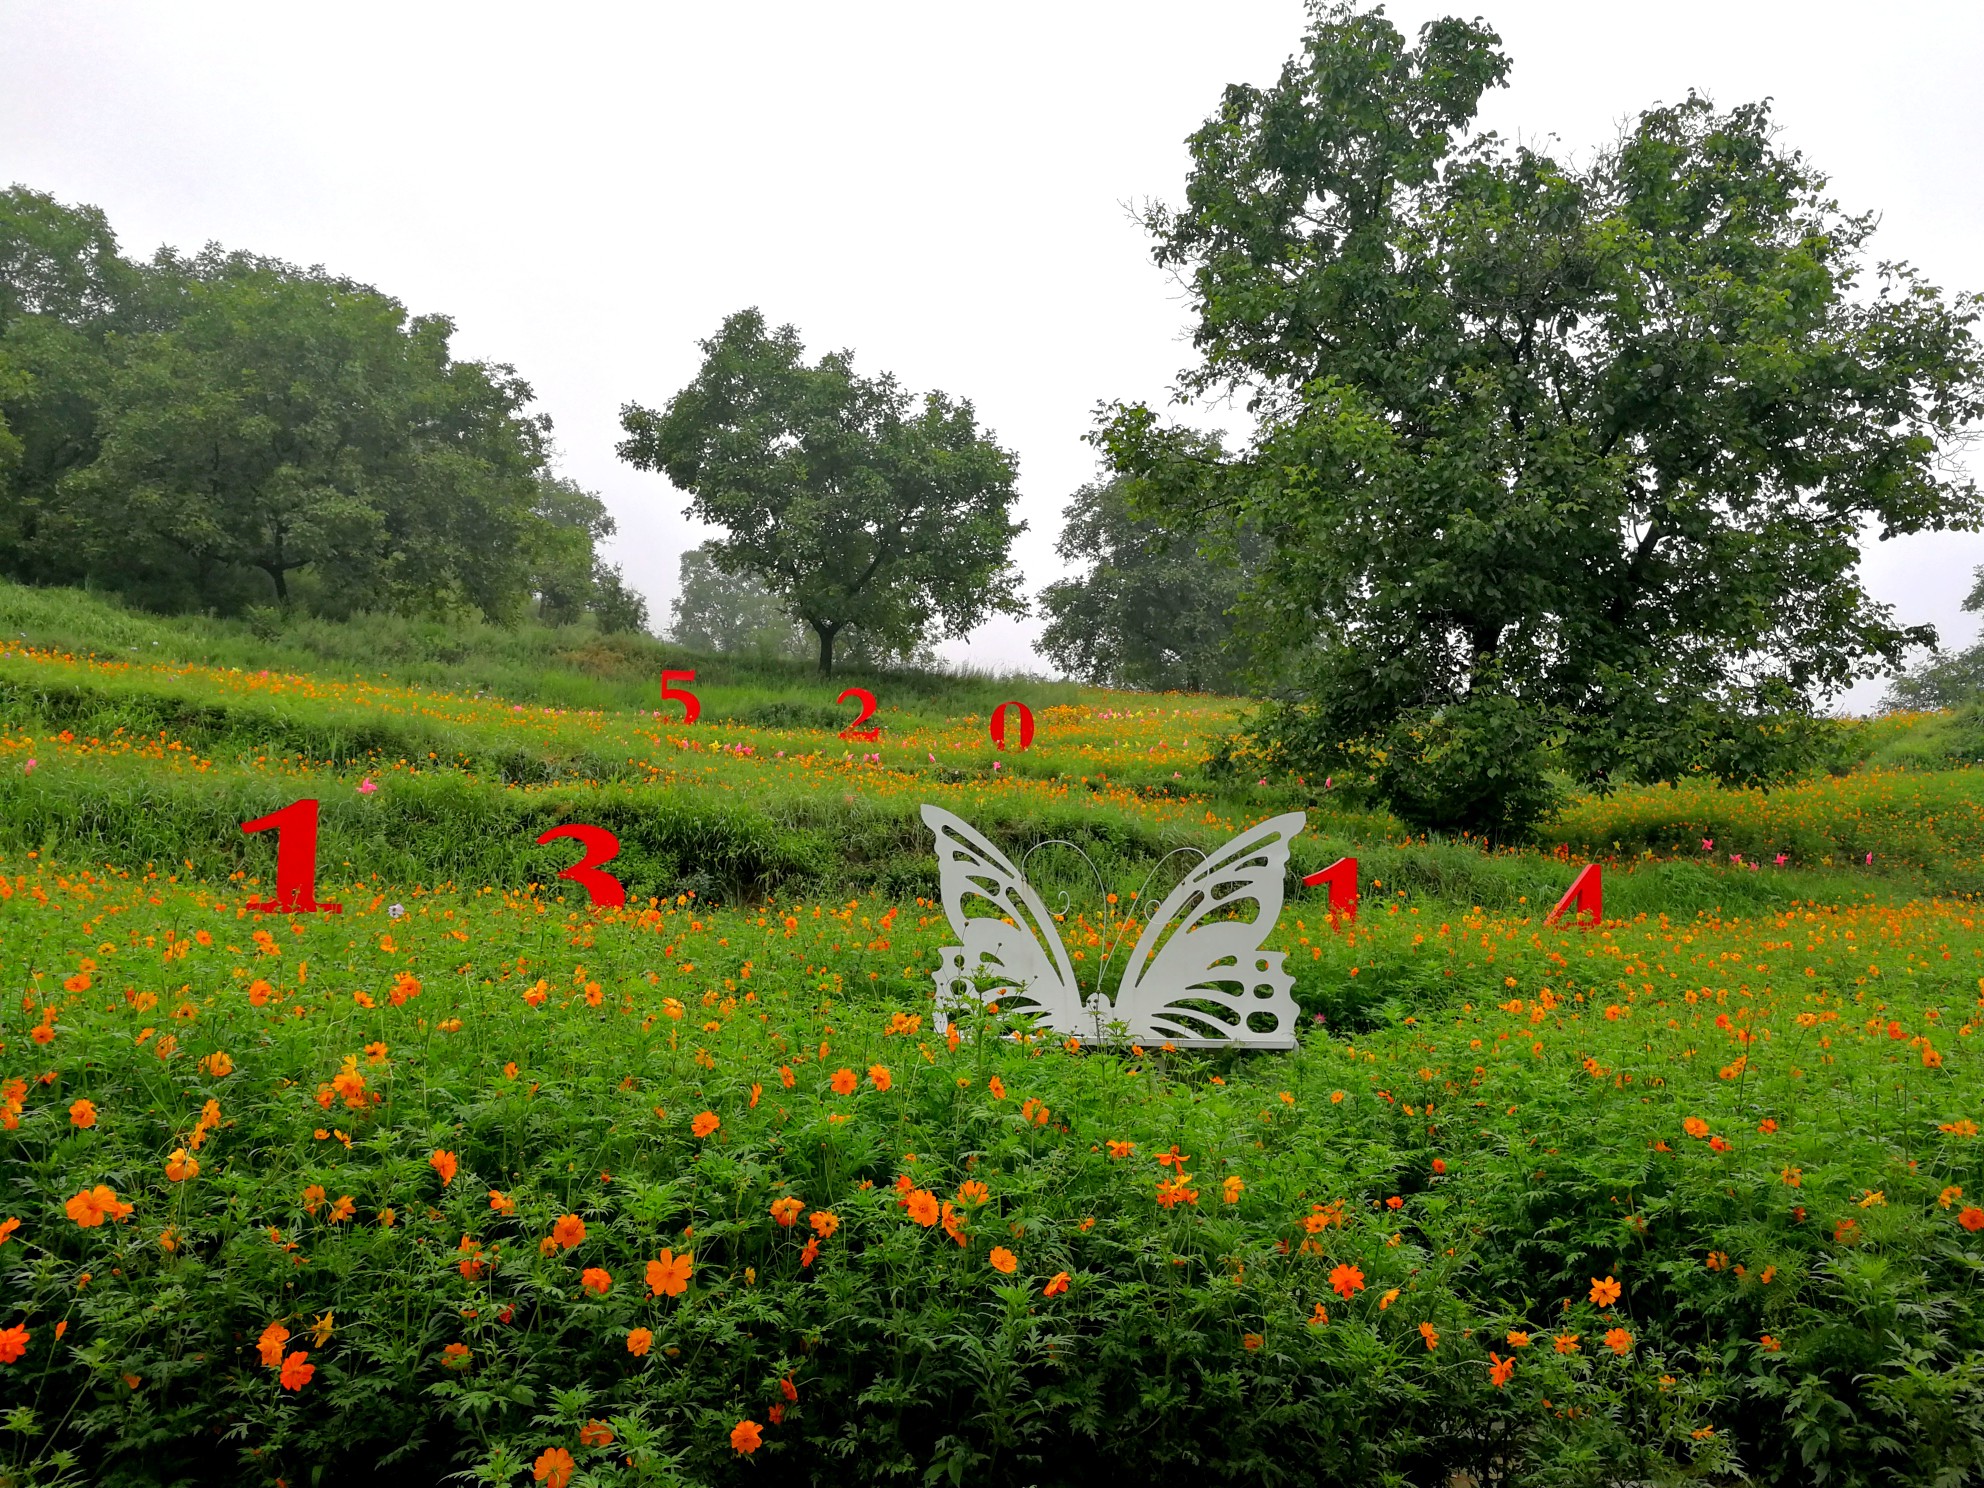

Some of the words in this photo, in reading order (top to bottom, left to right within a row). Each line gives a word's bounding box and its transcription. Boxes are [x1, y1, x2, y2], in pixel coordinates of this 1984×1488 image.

[837, 688, 880, 743] 2
[989, 701, 1035, 753] 0
[241, 799, 343, 914] 1
[535, 823, 627, 912] 3
[1303, 857, 1359, 936] 1
[1543, 863, 1603, 929] 4
